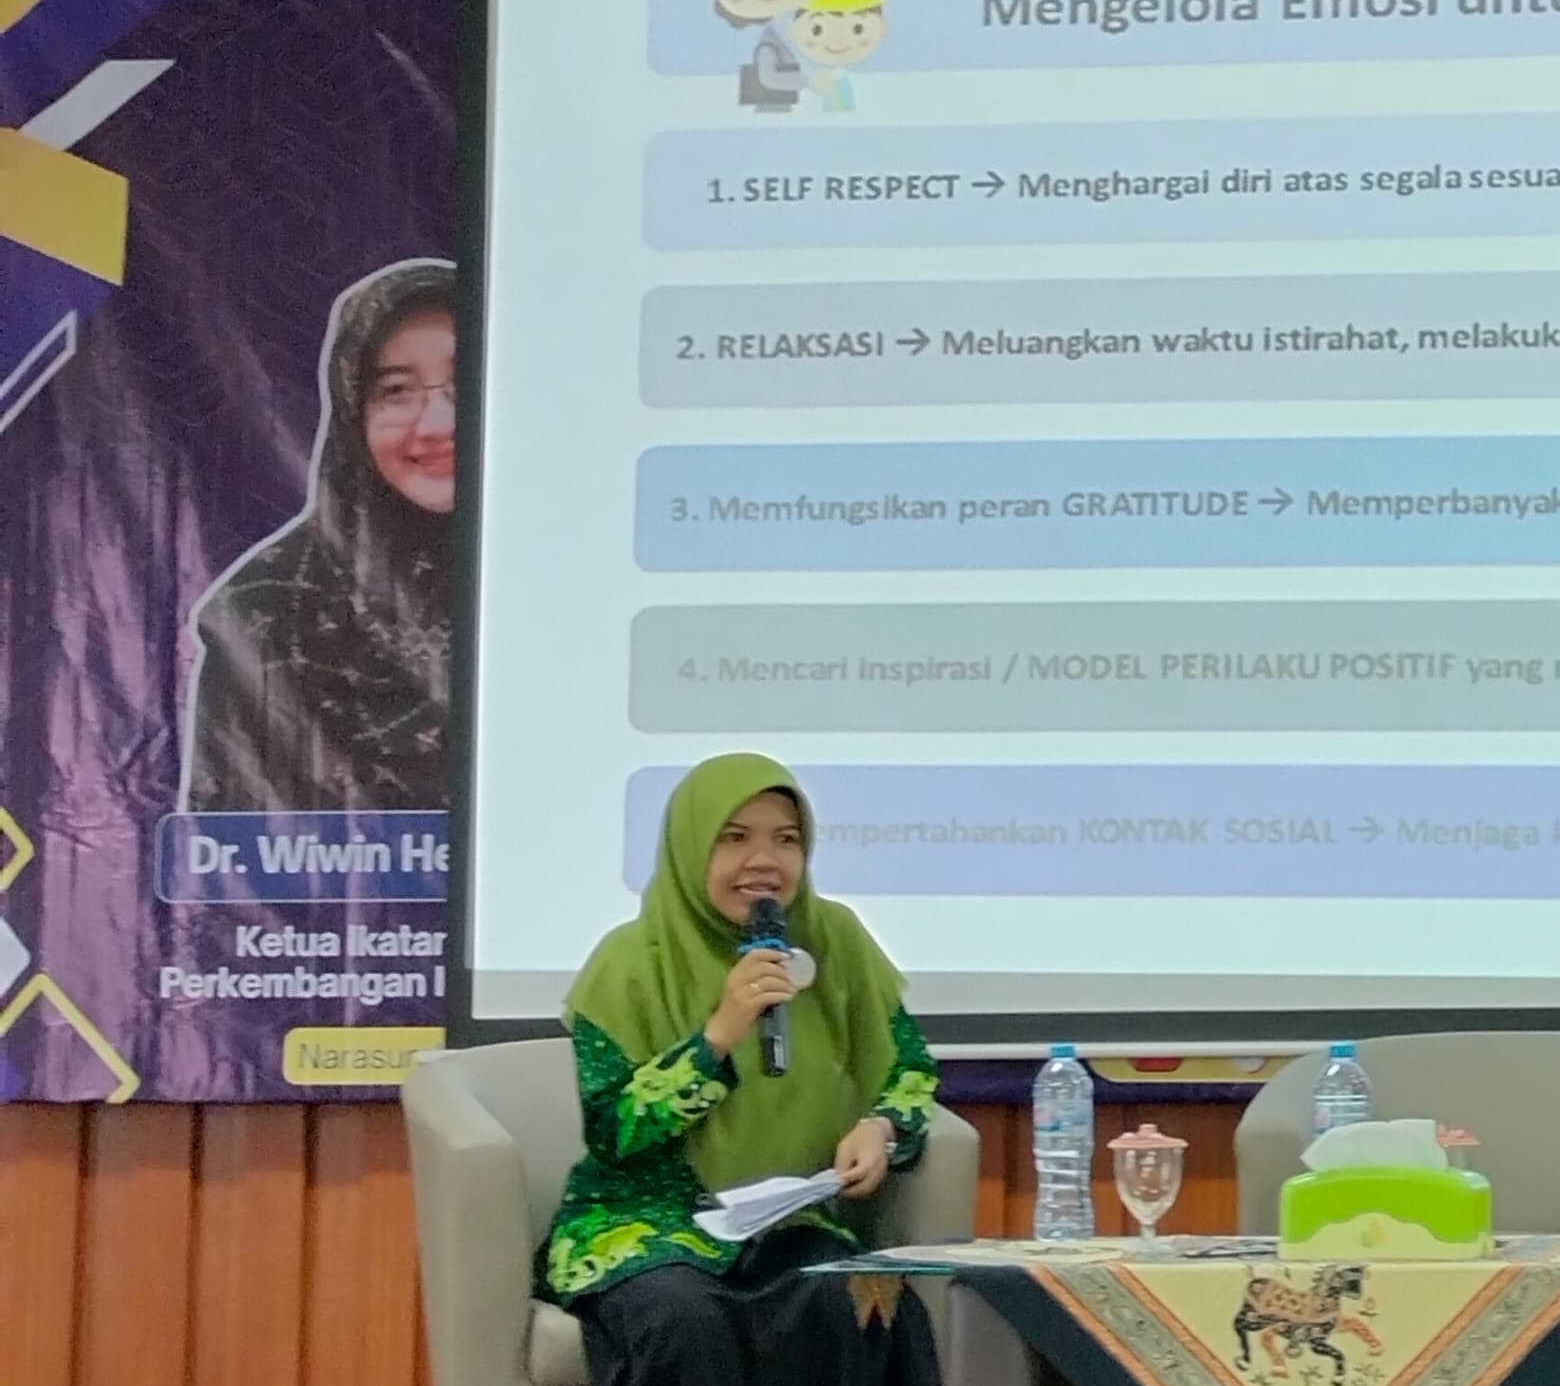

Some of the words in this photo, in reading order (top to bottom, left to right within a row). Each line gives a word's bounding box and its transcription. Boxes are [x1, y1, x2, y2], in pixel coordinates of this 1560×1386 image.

[707, 177, 736, 204] 1.
[742, 174, 814, 202] SELF
[824, 172, 961, 201] RESPECT
[1017, 167, 1210, 203] Menghargai
[1219, 166, 1272, 195] diri
[1282, 167, 1349, 194] atas
[1359, 162, 1464, 198] segala
[676, 333, 705, 360] 2.
[716, 330, 884, 360] RELAKSASI
[941, 325, 1141, 361] Meluangkan
[1150, 325, 1254, 354] waktu
[1262, 322, 1410, 355] istirahat,
[670, 494, 699, 522] 3.
[708, 492, 947, 527] Memfungsikan
[957, 496, 1051, 526] peran
[1060, 488, 1249, 518] GRATITUDE
[676, 655, 709, 683] 4.
[717, 655, 848, 683] Mencari
[1026, 652, 1148, 682] MODEL
[1158, 651, 1321, 681] PERILAKU
[1328, 651, 1456, 681] POSITIF
[1463, 656, 1544, 687] yang
[810, 815, 1068, 848] empertahankan
[1078, 816, 1209, 845] KONTAK
[1223, 816, 1337, 846] SOSIAL
[1396, 816, 1542, 851] Menjaga
[187, 835, 249, 874] Dr.
[257, 832, 393, 874] Wiwin
[235, 925, 341, 957] Ketua
[159, 966, 428, 1006] Perkembangan
